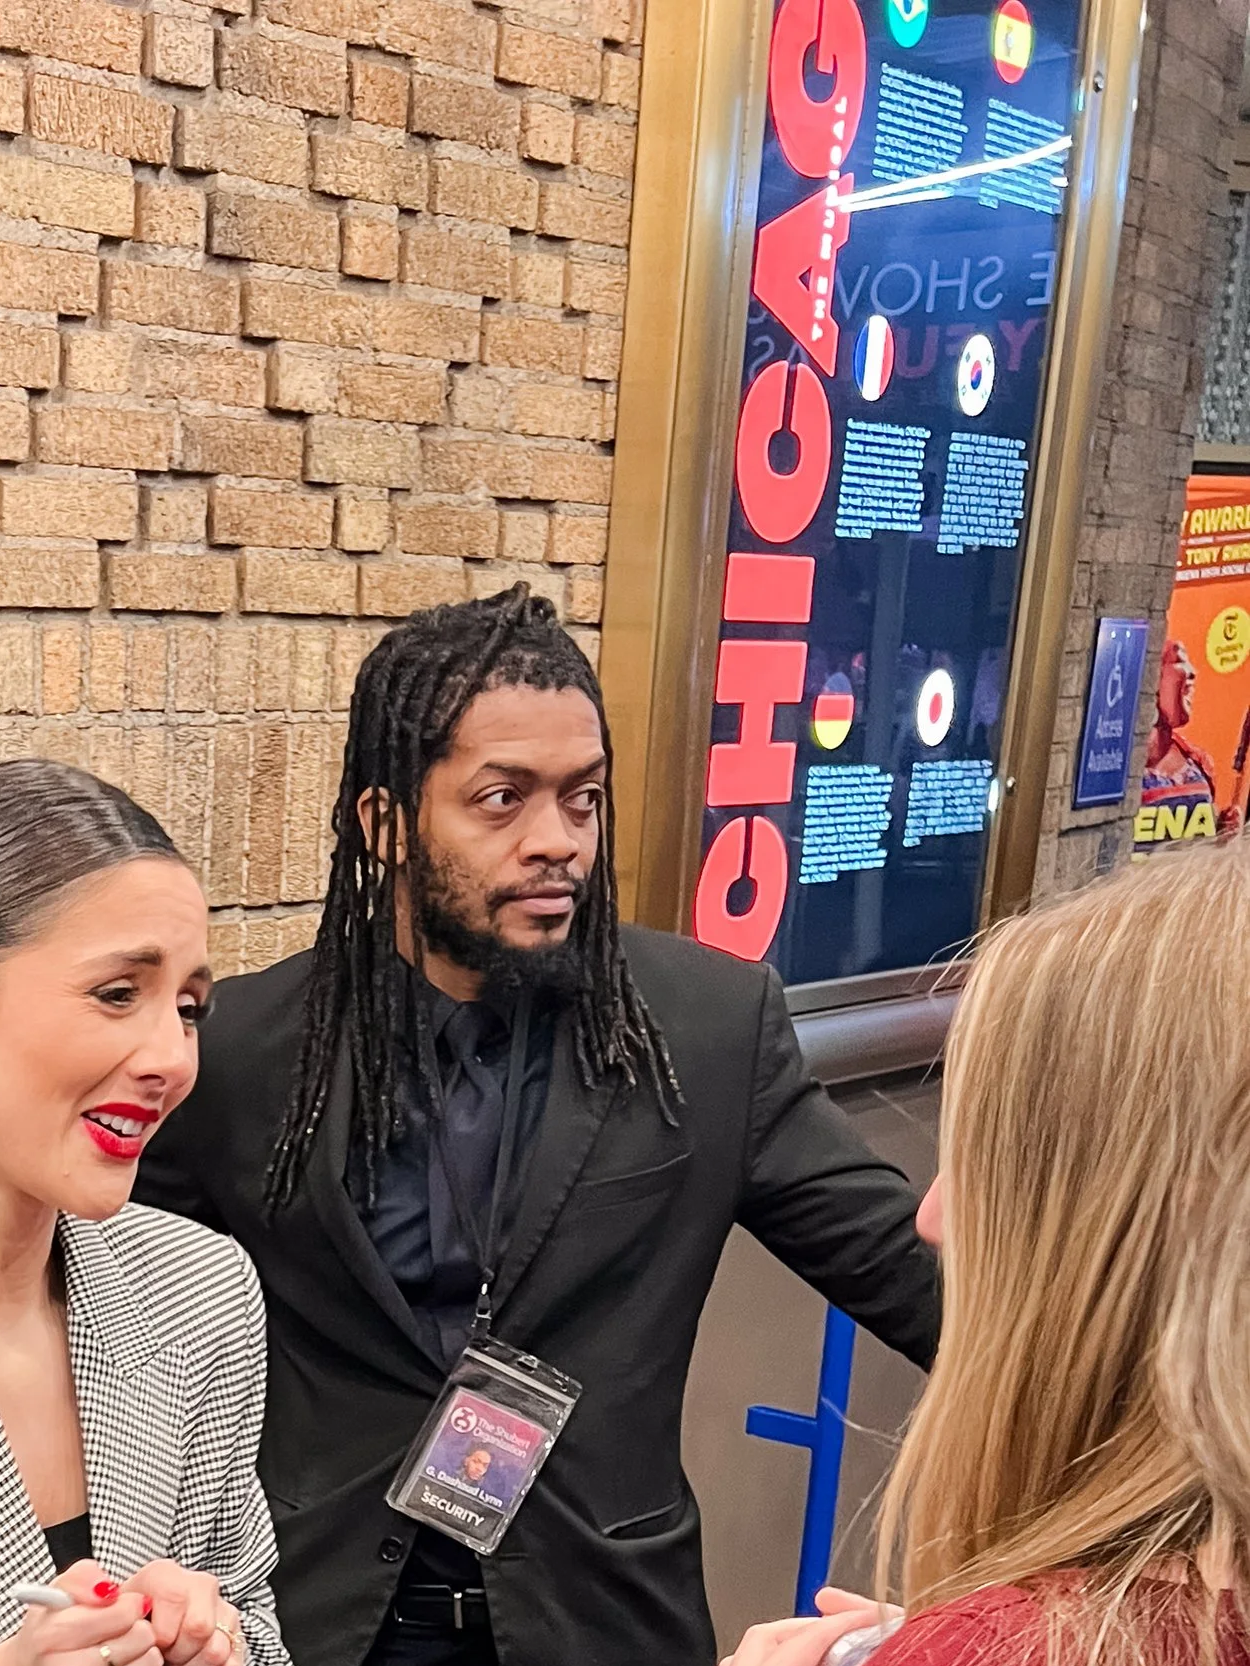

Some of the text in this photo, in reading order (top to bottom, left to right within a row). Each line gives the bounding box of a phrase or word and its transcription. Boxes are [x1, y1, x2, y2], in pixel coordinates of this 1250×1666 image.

[810, 276, 828, 342] THE
[1133, 803, 1216, 842] ENA
[421, 1490, 485, 1528] SECURITY
